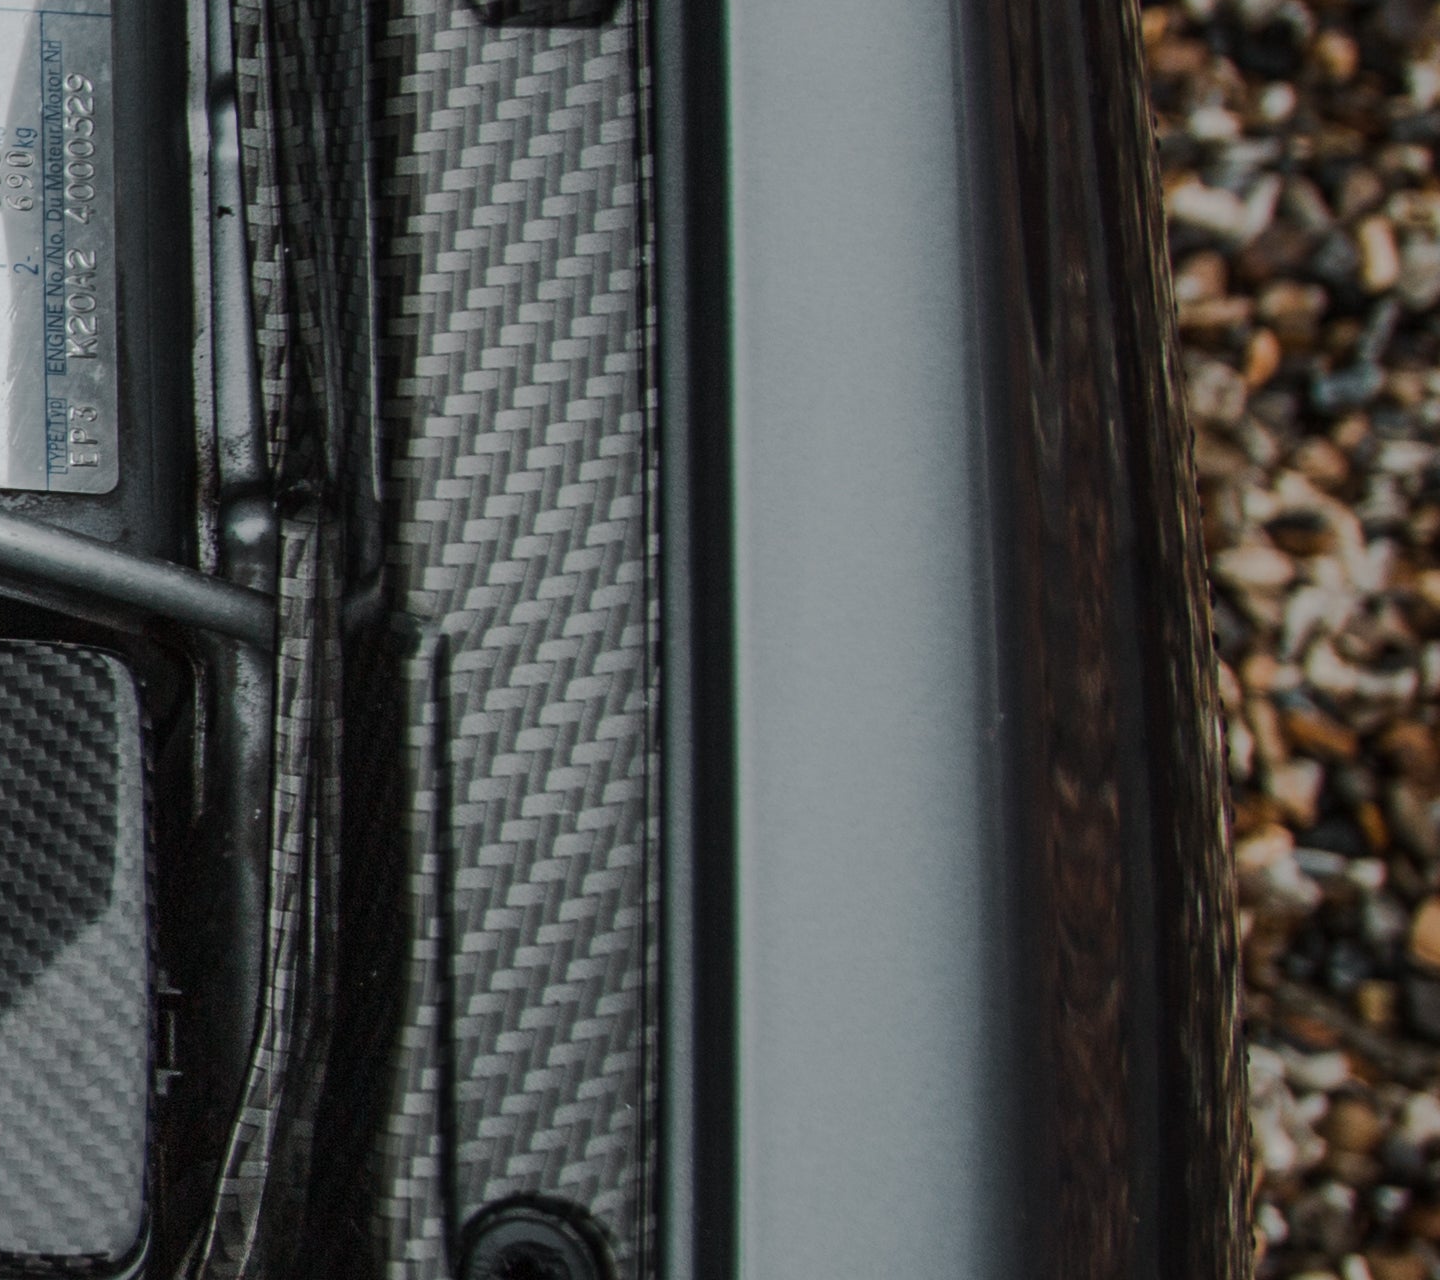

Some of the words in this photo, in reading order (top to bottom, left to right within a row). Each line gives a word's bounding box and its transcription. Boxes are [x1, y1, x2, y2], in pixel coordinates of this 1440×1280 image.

[45, 67, 65, 191] Moteur/Motor
[63, 72, 97, 225] 4000529
[46, 197, 65, 222] Du
[46, 303, 65, 373] ENGINE
[65, 248, 97, 360] K20A2
[47, 399, 67, 471] TYPE/Typ
[67, 405, 99, 468] EP3
